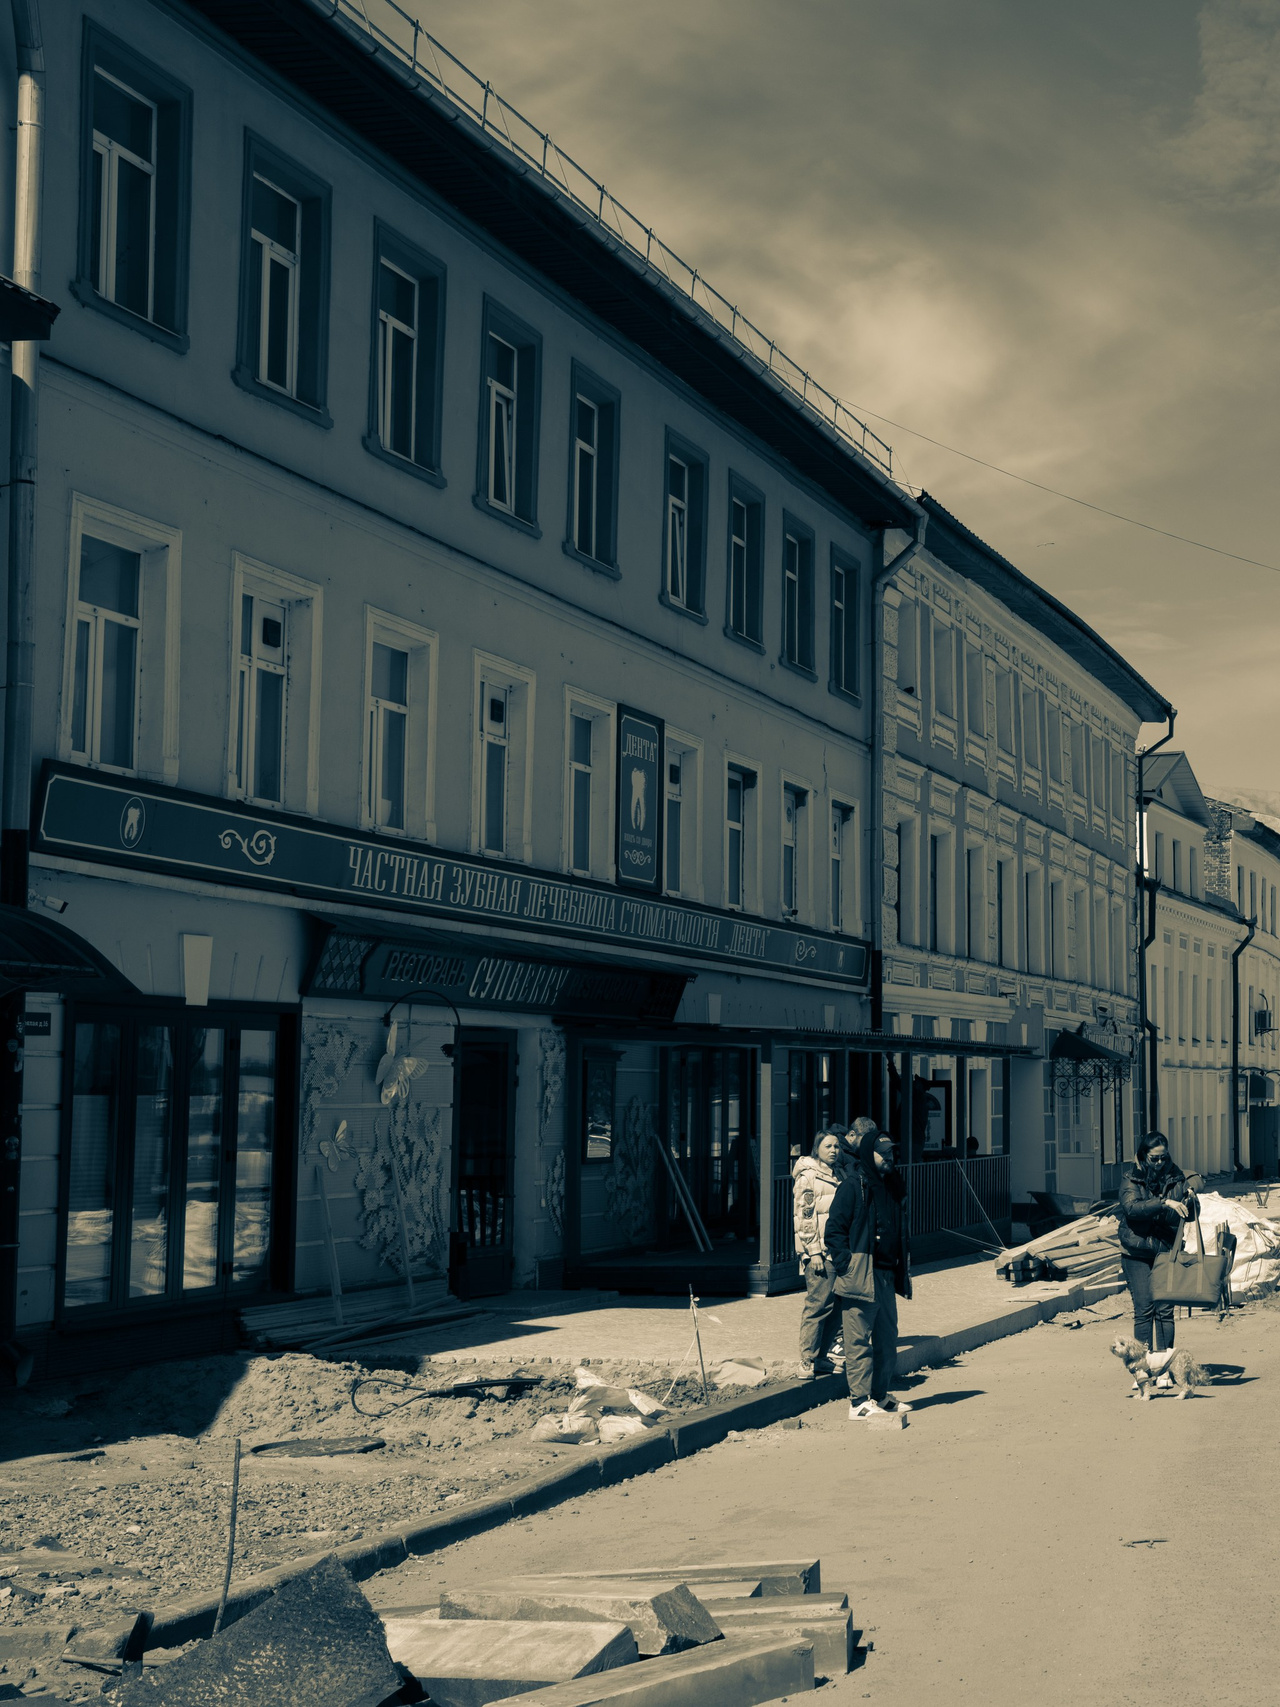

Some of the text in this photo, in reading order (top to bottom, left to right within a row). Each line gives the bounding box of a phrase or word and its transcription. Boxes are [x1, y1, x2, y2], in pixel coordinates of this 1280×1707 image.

[350, 845, 446, 901] ЧАСТНАЯ
[450, 866, 522, 915] ЗУБНАЯ
[524, 882, 615, 932] ЛЕЧЕБНИЦА
[619, 901, 720, 949] СТОМАТОЛОГІЯ
